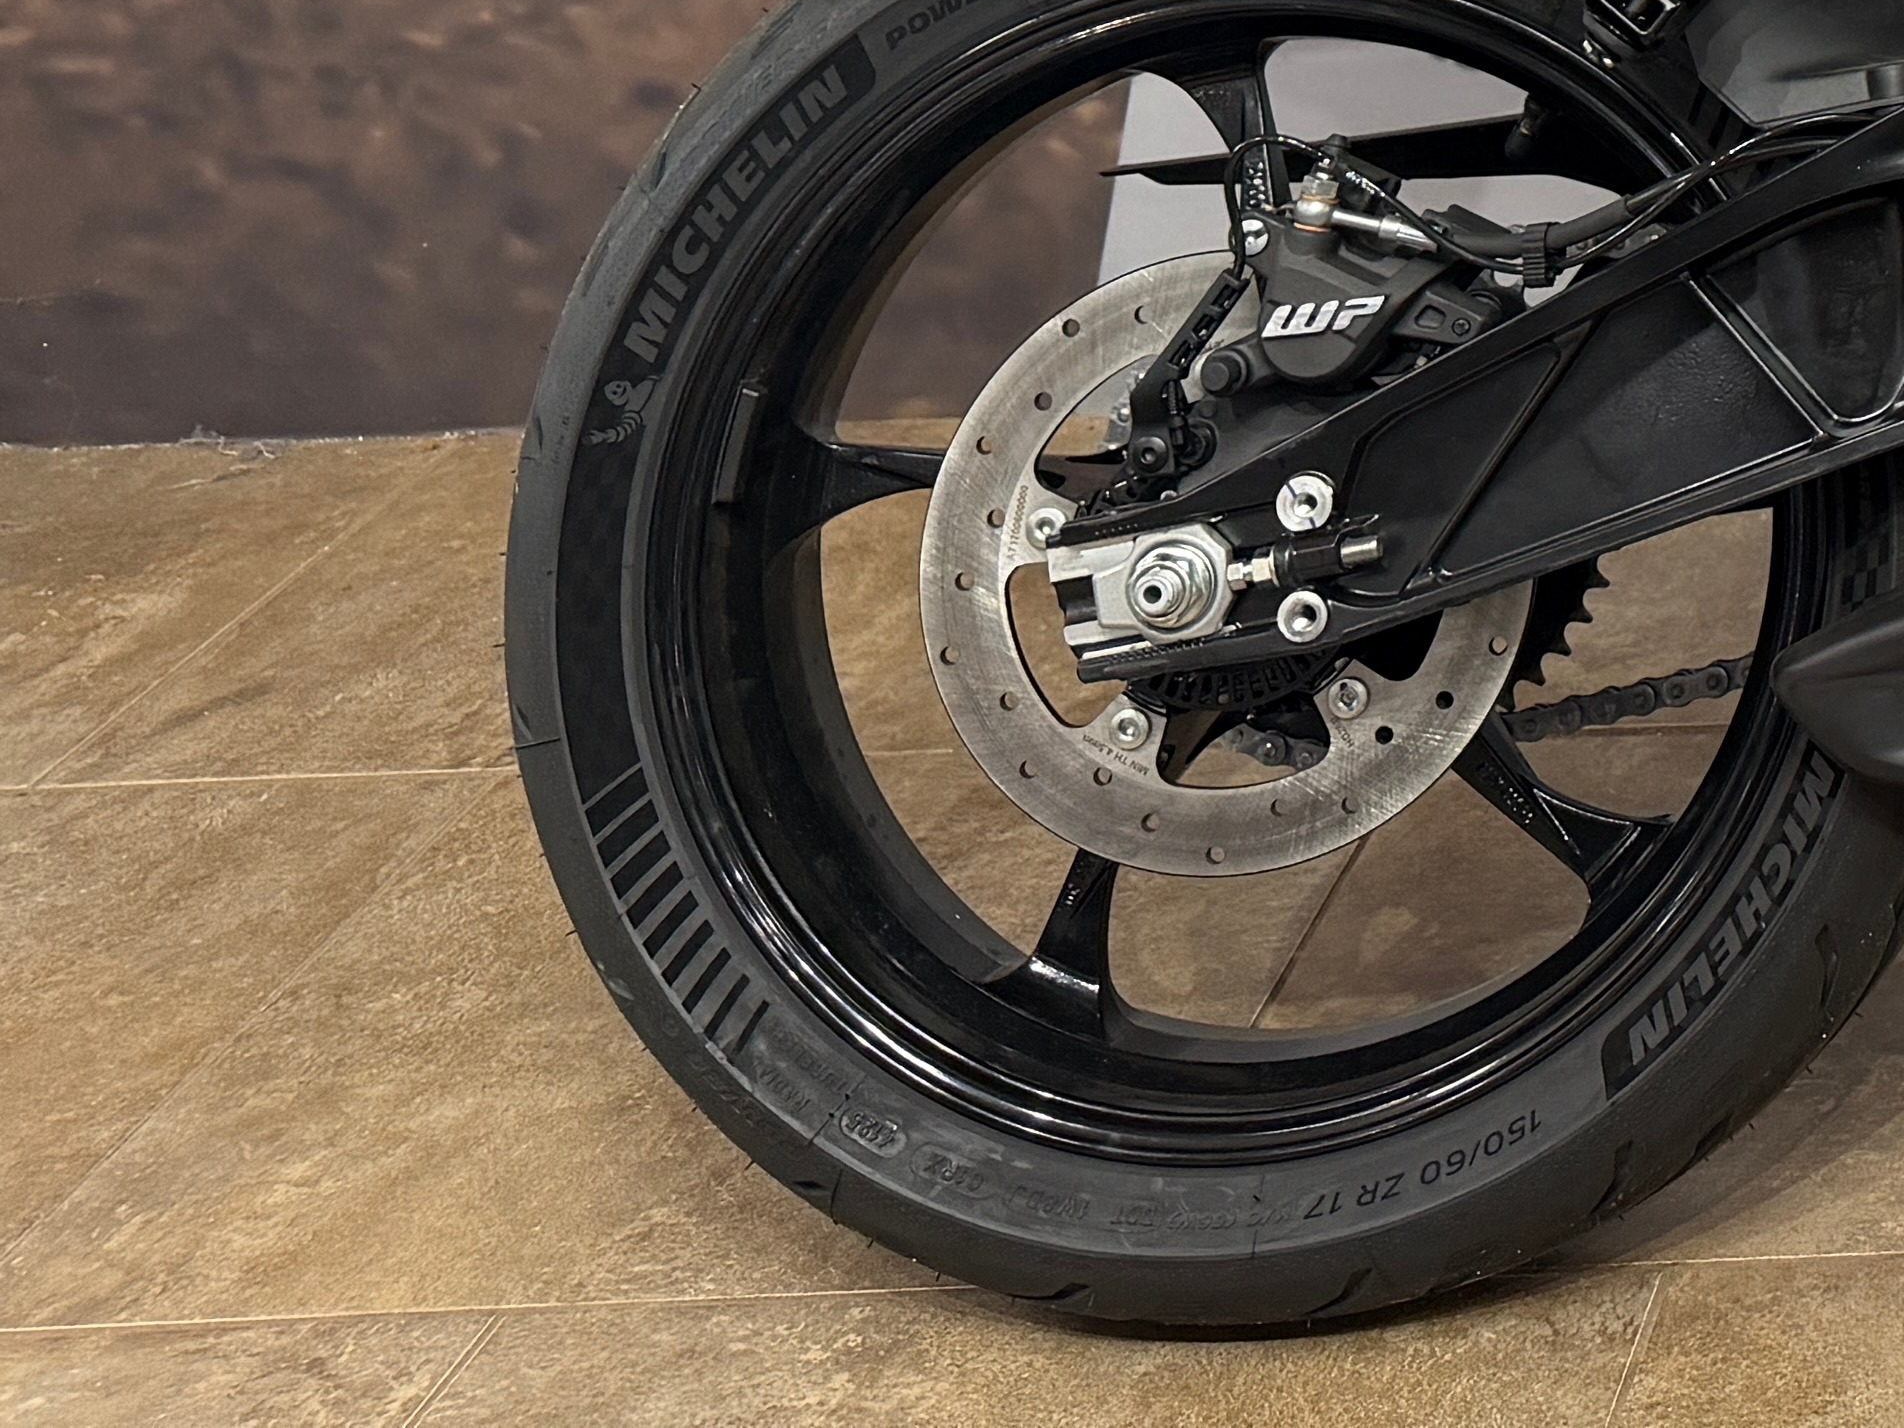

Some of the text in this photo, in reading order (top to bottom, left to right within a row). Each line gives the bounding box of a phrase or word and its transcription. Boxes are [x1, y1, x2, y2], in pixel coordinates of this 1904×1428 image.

[623, 63, 849, 364] MICHELIN
[1261, 295, 1386, 338] WP
[1627, 749, 1837, 1067] MICHELIN
[1419, 1107, 1542, 1187] 150/60
[1303, 1191, 1351, 1220] 17
[1356, 1172, 1406, 1208] ZR
